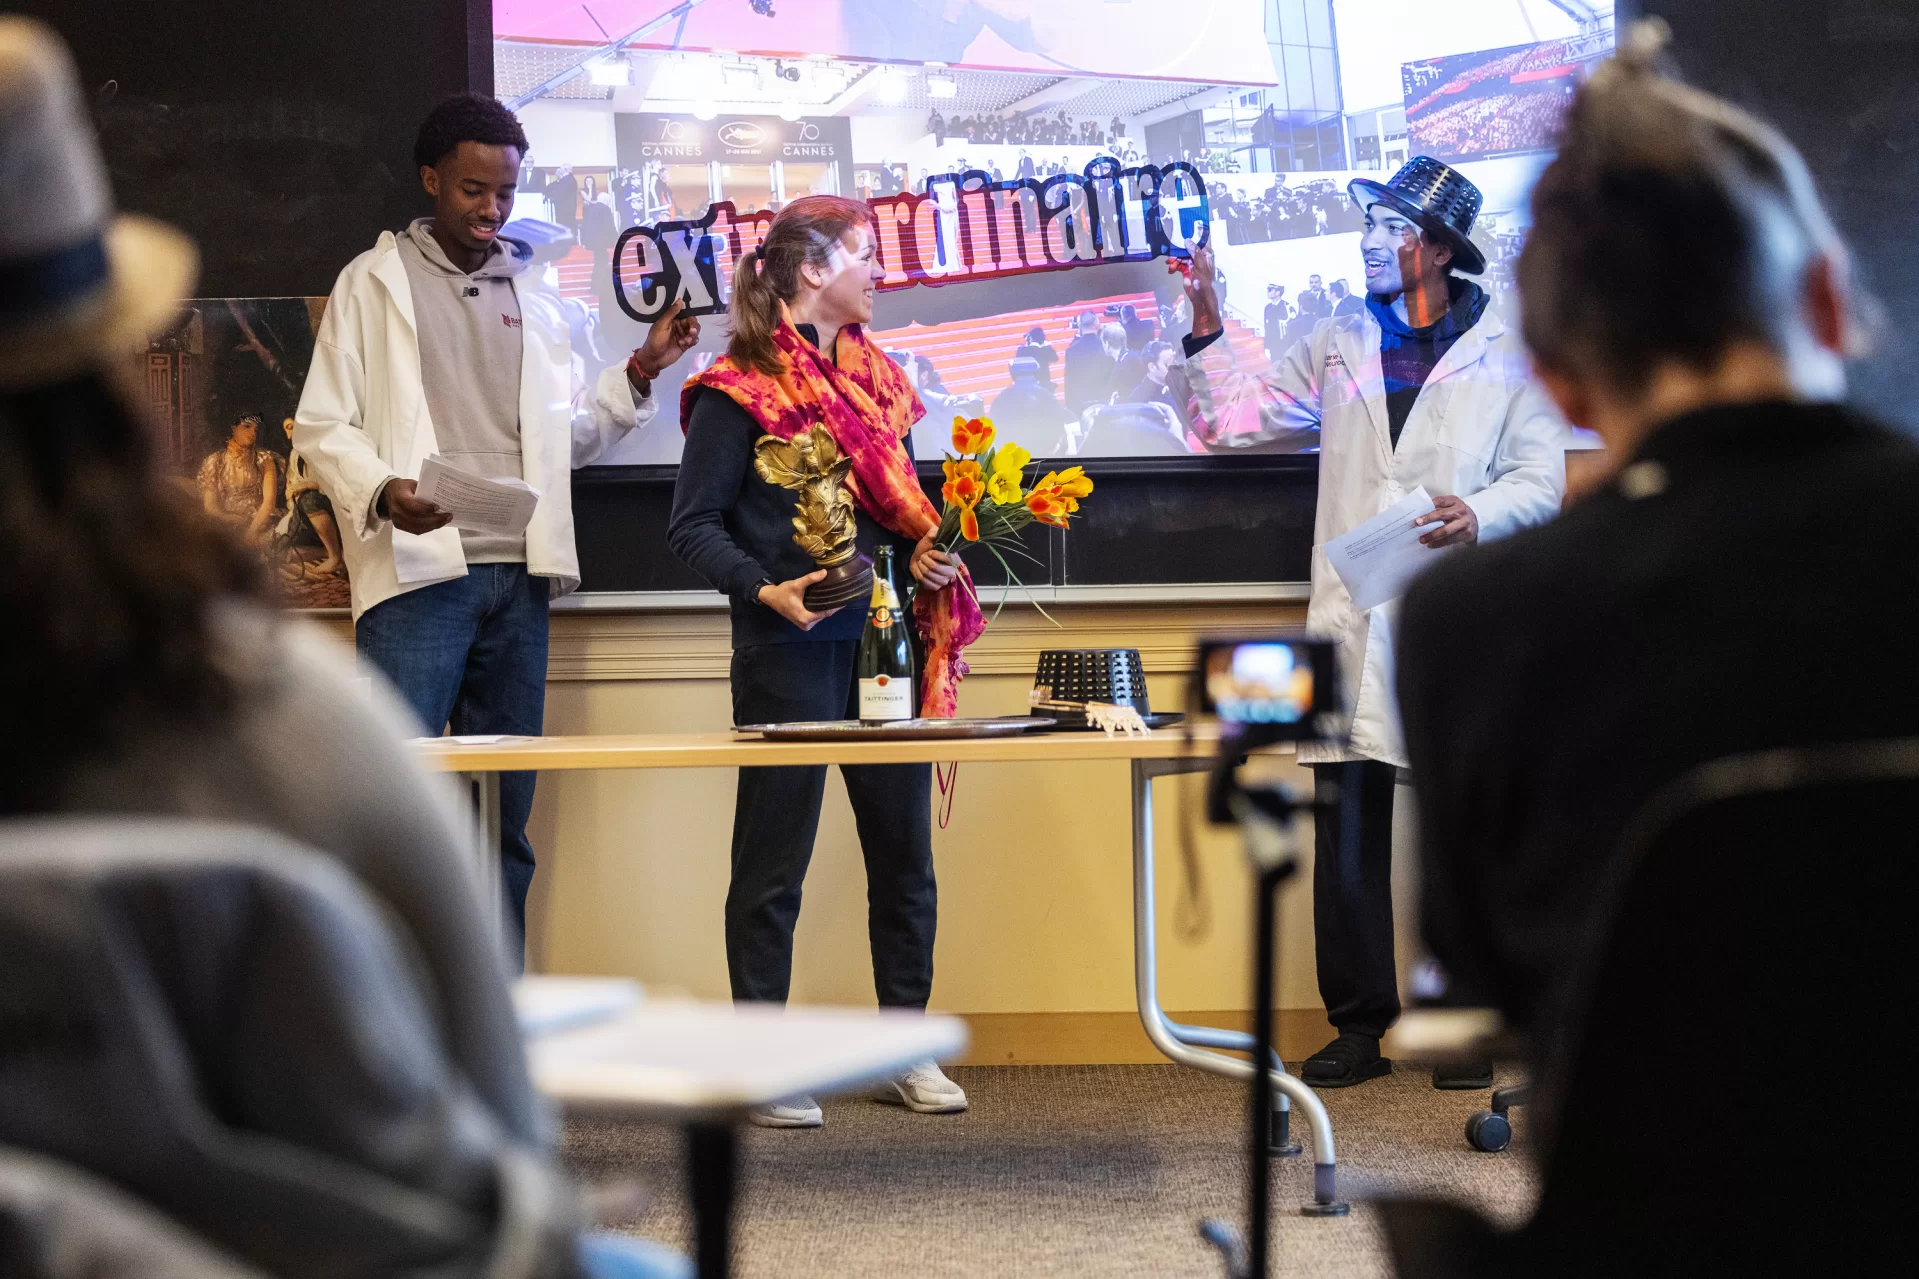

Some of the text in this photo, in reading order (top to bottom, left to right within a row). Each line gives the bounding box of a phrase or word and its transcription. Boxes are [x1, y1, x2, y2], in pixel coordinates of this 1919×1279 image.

[657, 118, 685, 140] 70
[796, 121, 820, 140] 70
[641, 146, 702, 157] CANNES
[782, 146, 835, 156] CANNES
[613, 156, 1209, 321] extrrdinaire
